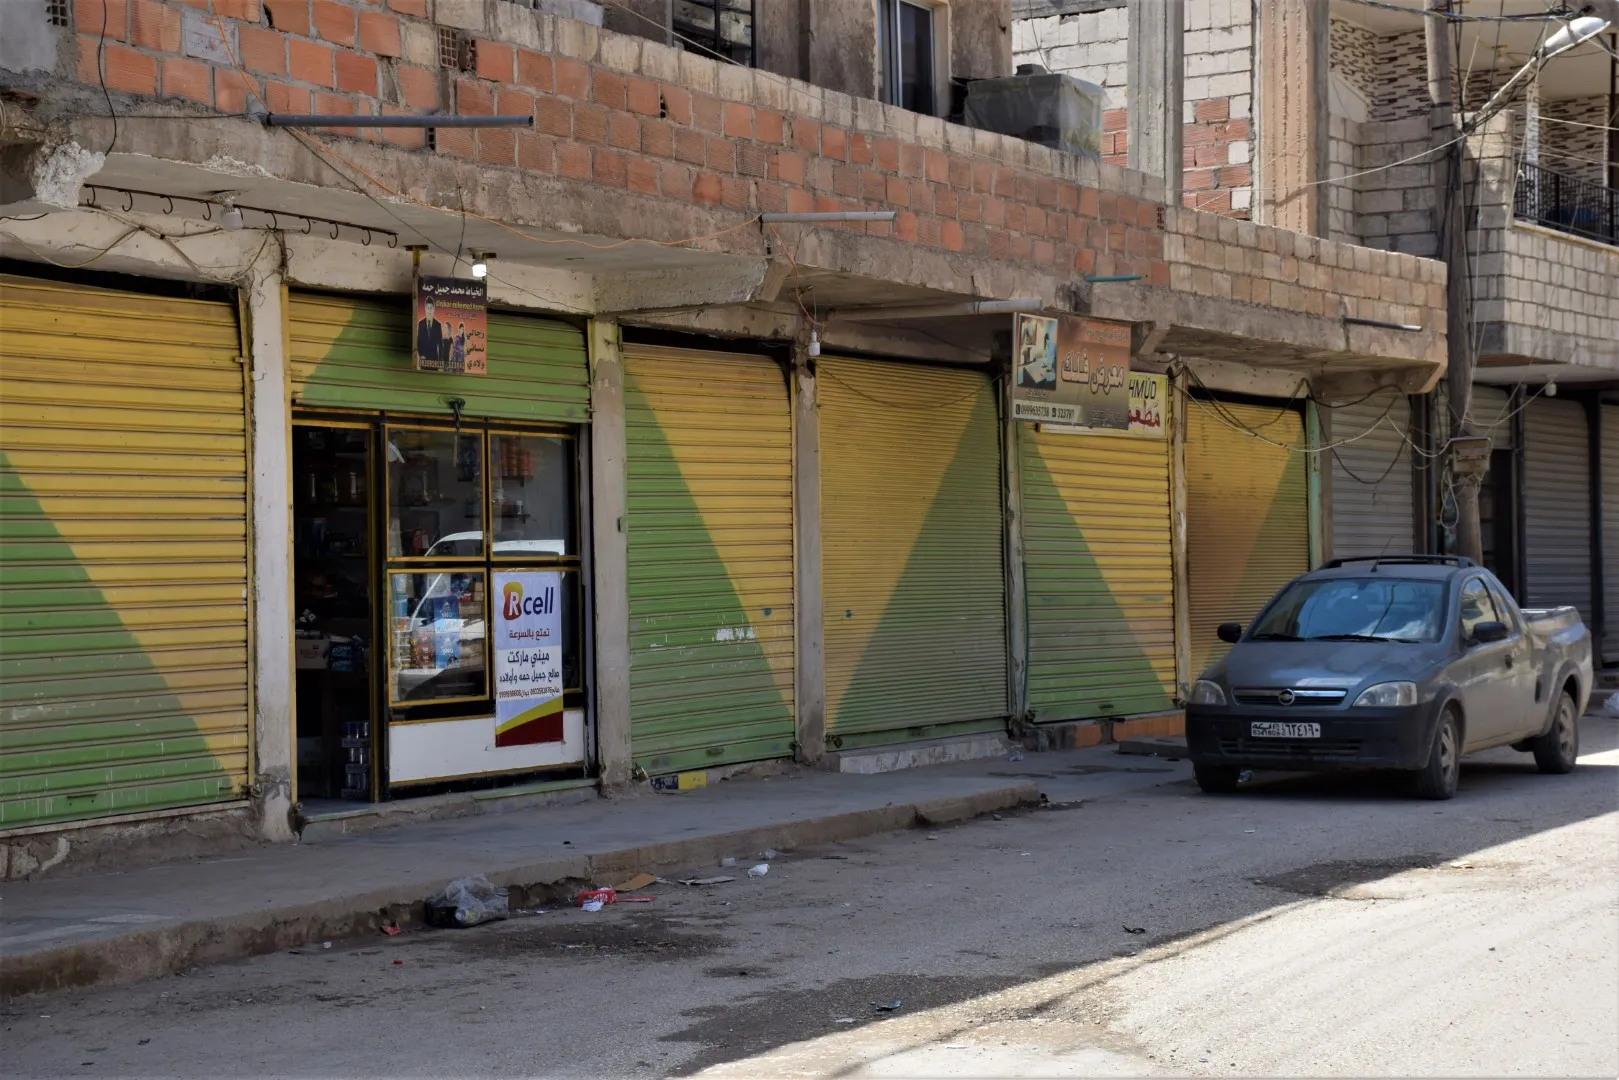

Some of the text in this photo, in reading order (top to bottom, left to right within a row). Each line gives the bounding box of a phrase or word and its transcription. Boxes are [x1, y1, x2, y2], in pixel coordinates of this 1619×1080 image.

[434, 283, 450, 295] جميل
[450, 286, 465, 295] محمد
[465, 286, 484, 299] الخياط
[466, 328, 485, 340] رجالي
[466, 343, 485, 355] نسائي
[466, 359, 485, 371] ولادي
[1061, 347, 1125, 395] معرض فلك
[506, 585, 554, 617] Rcell
[509, 628, 550, 640] تمتع بالسرعة
[507, 649, 550, 668] ميني ماركت
[518, 673, 530, 681] حمه
[531, 669, 546, 683] جميل
[547, 668, 560, 683] صالح
